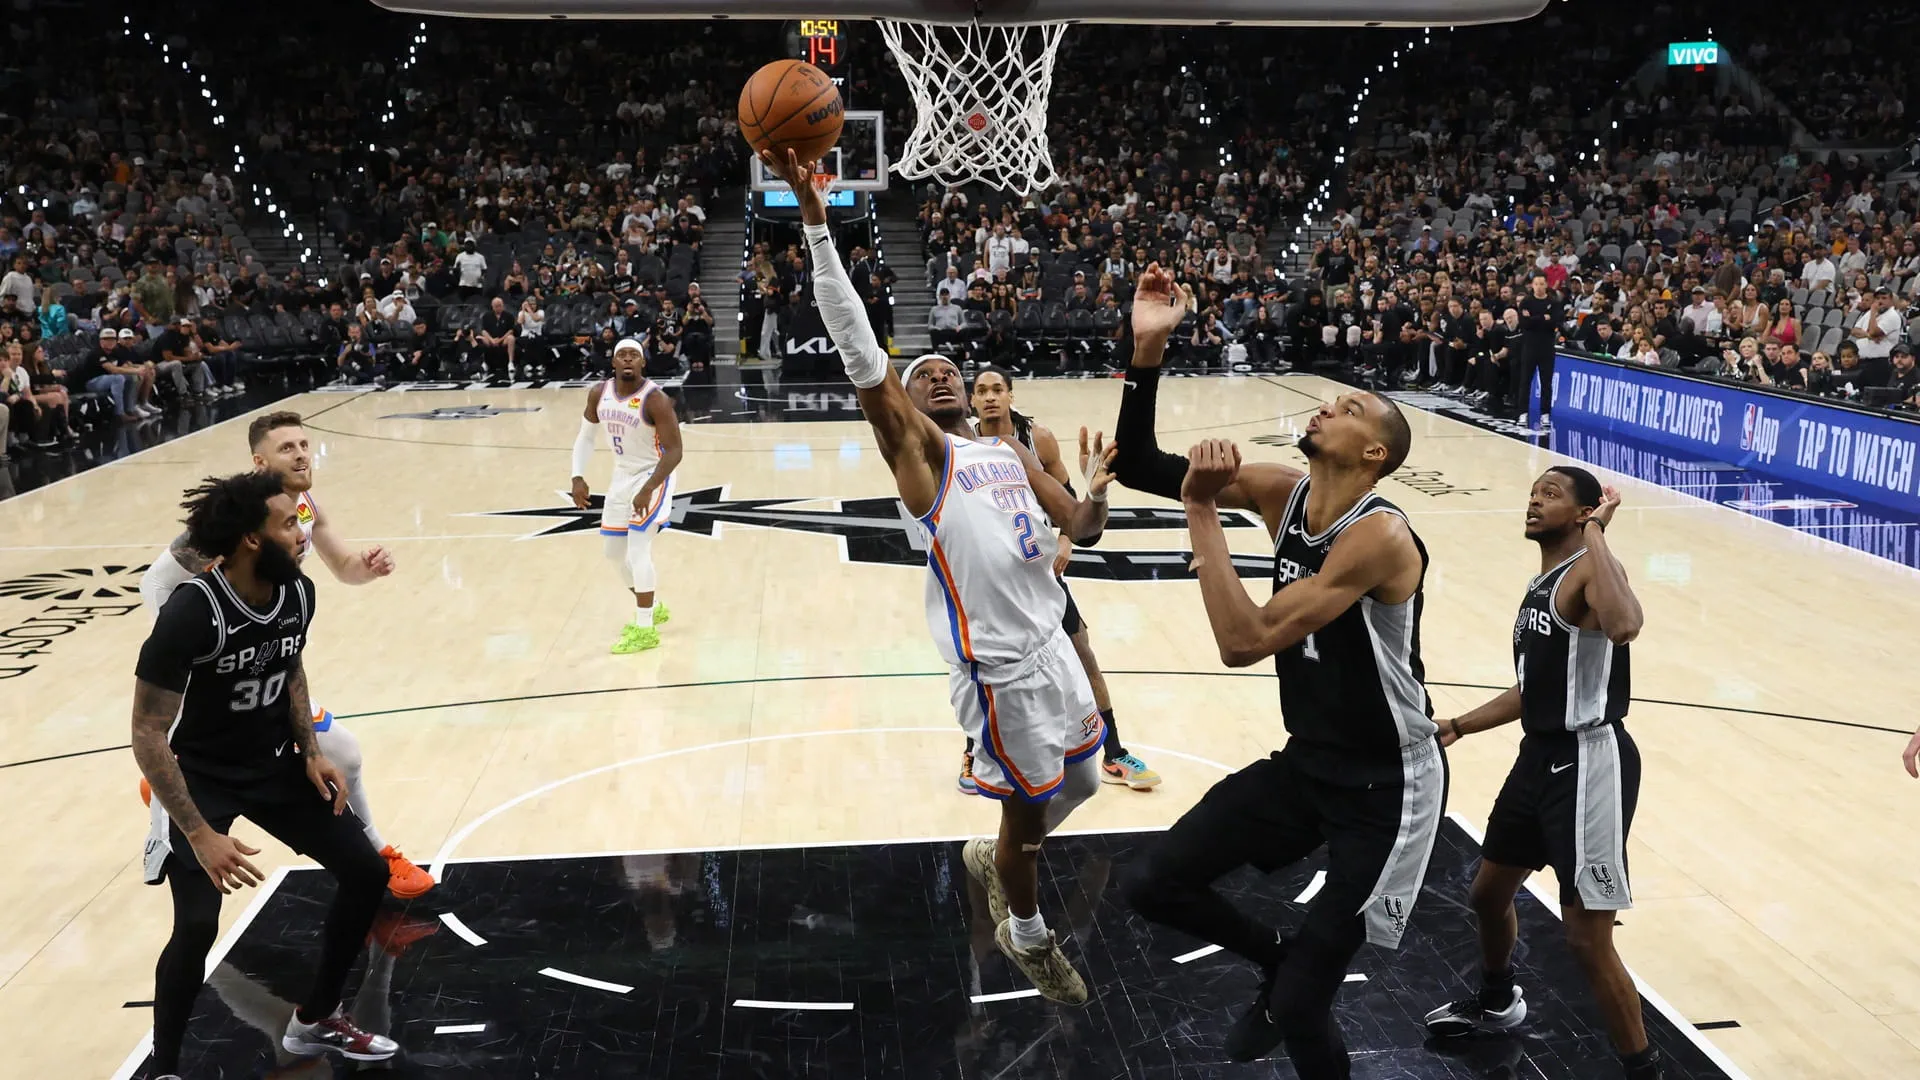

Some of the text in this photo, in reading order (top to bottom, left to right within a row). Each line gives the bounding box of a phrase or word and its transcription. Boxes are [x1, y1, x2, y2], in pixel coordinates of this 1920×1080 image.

[801, 20, 838, 36] 10:54
[810, 37, 835, 65] 14
[786, 337, 838, 354] KI
[1568, 371, 1588, 410] TAP
[1588, 375, 1602, 414] TO
[1602, 378, 1640, 424] WATCH
[1640, 386, 1664, 430] THE
[1662, 390, 1723, 445] PLAYOFFS
[607, 422, 625, 436] CITY
[1751, 406, 1780, 465] App
[613, 436, 624, 455] 5
[1796, 418, 1828, 470] TAP
[1828, 425, 1852, 478] TO
[1852, 430, 1917, 494] WATCH
[955, 461, 1026, 493] OKLAHO
[992, 488, 1030, 511] CITY
[1012, 511, 1043, 563] 2
[231, 670, 286, 711] 30
